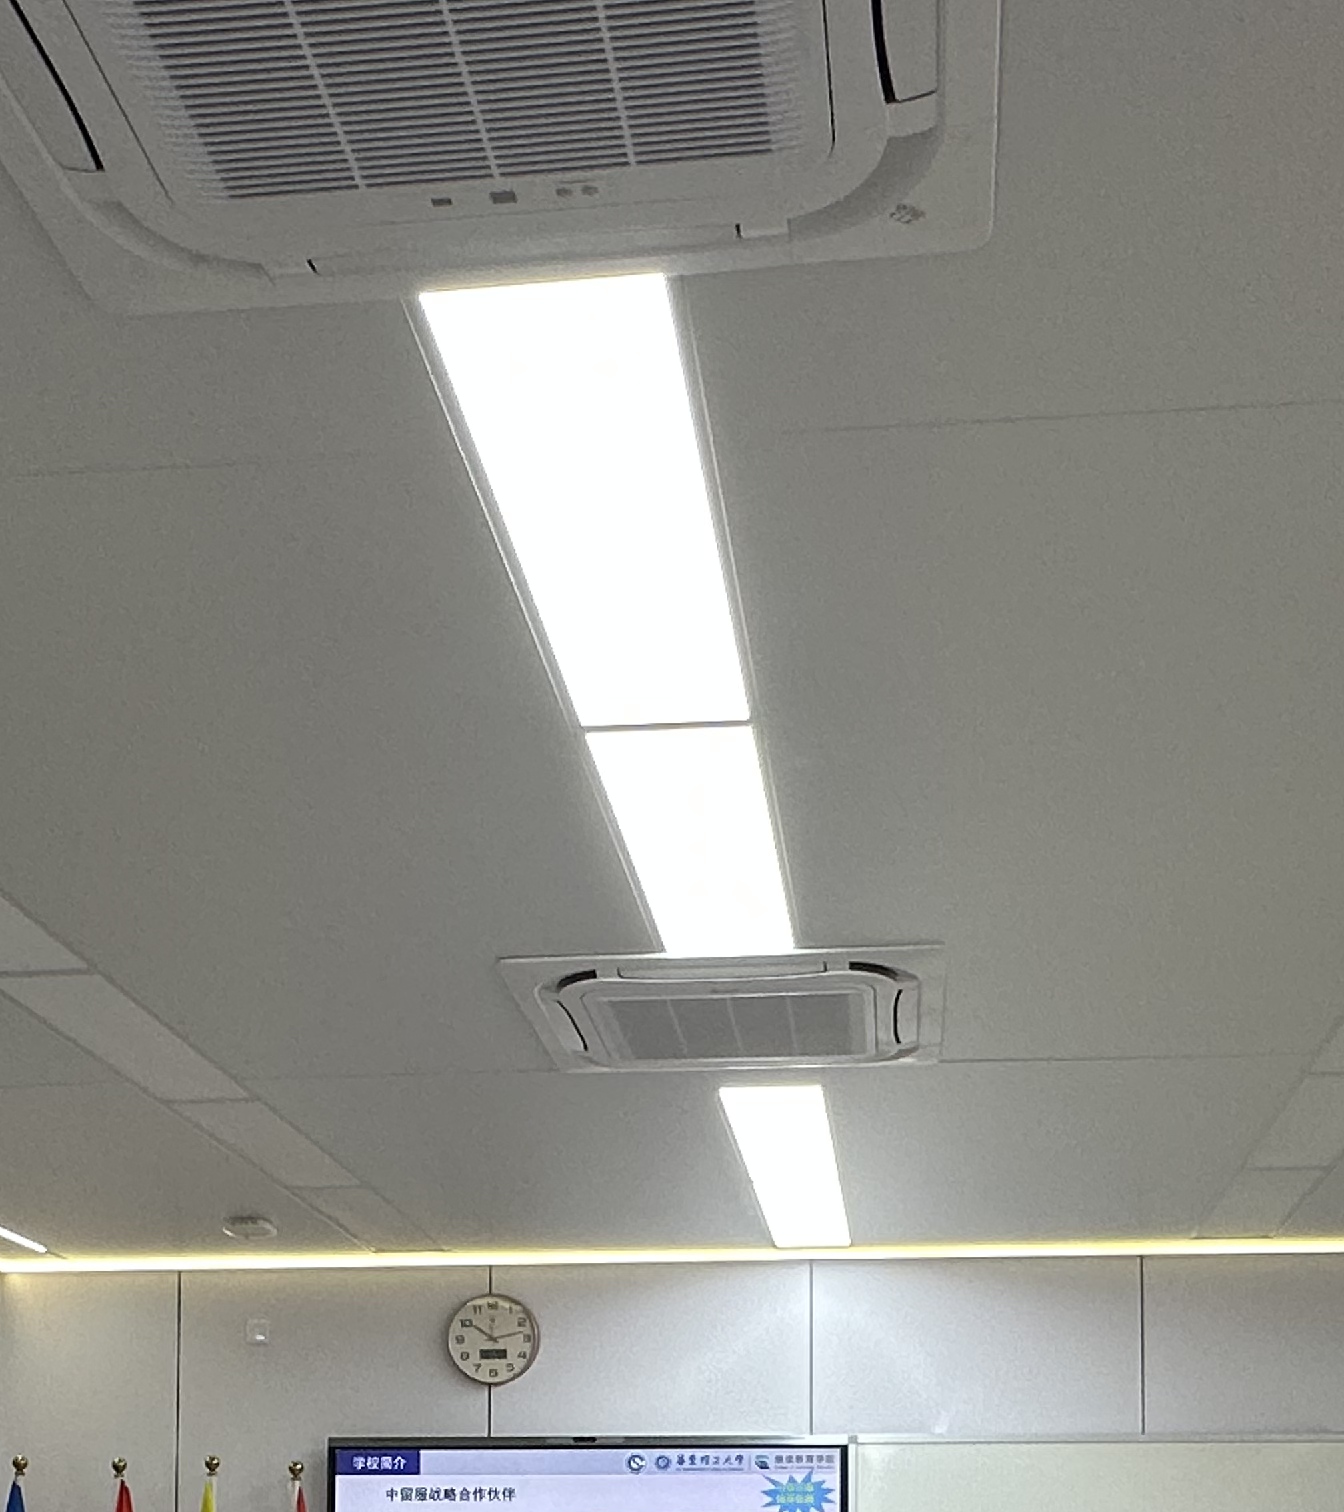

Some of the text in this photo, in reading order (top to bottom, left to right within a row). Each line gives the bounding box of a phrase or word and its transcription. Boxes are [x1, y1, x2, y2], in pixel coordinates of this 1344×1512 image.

[473, 1305, 483, 1315] 11
[459, 1319, 473, 1328] 10
[517, 1317, 527, 1327] 2
[455, 1334, 465, 1344] 9
[517, 1351, 527, 1359] 4
[473, 1363, 482, 1373] 7
[352, 1455, 407, 1470] 学校简介
[386, 1486, 517, 1502] 中留服战略合作伙伴
